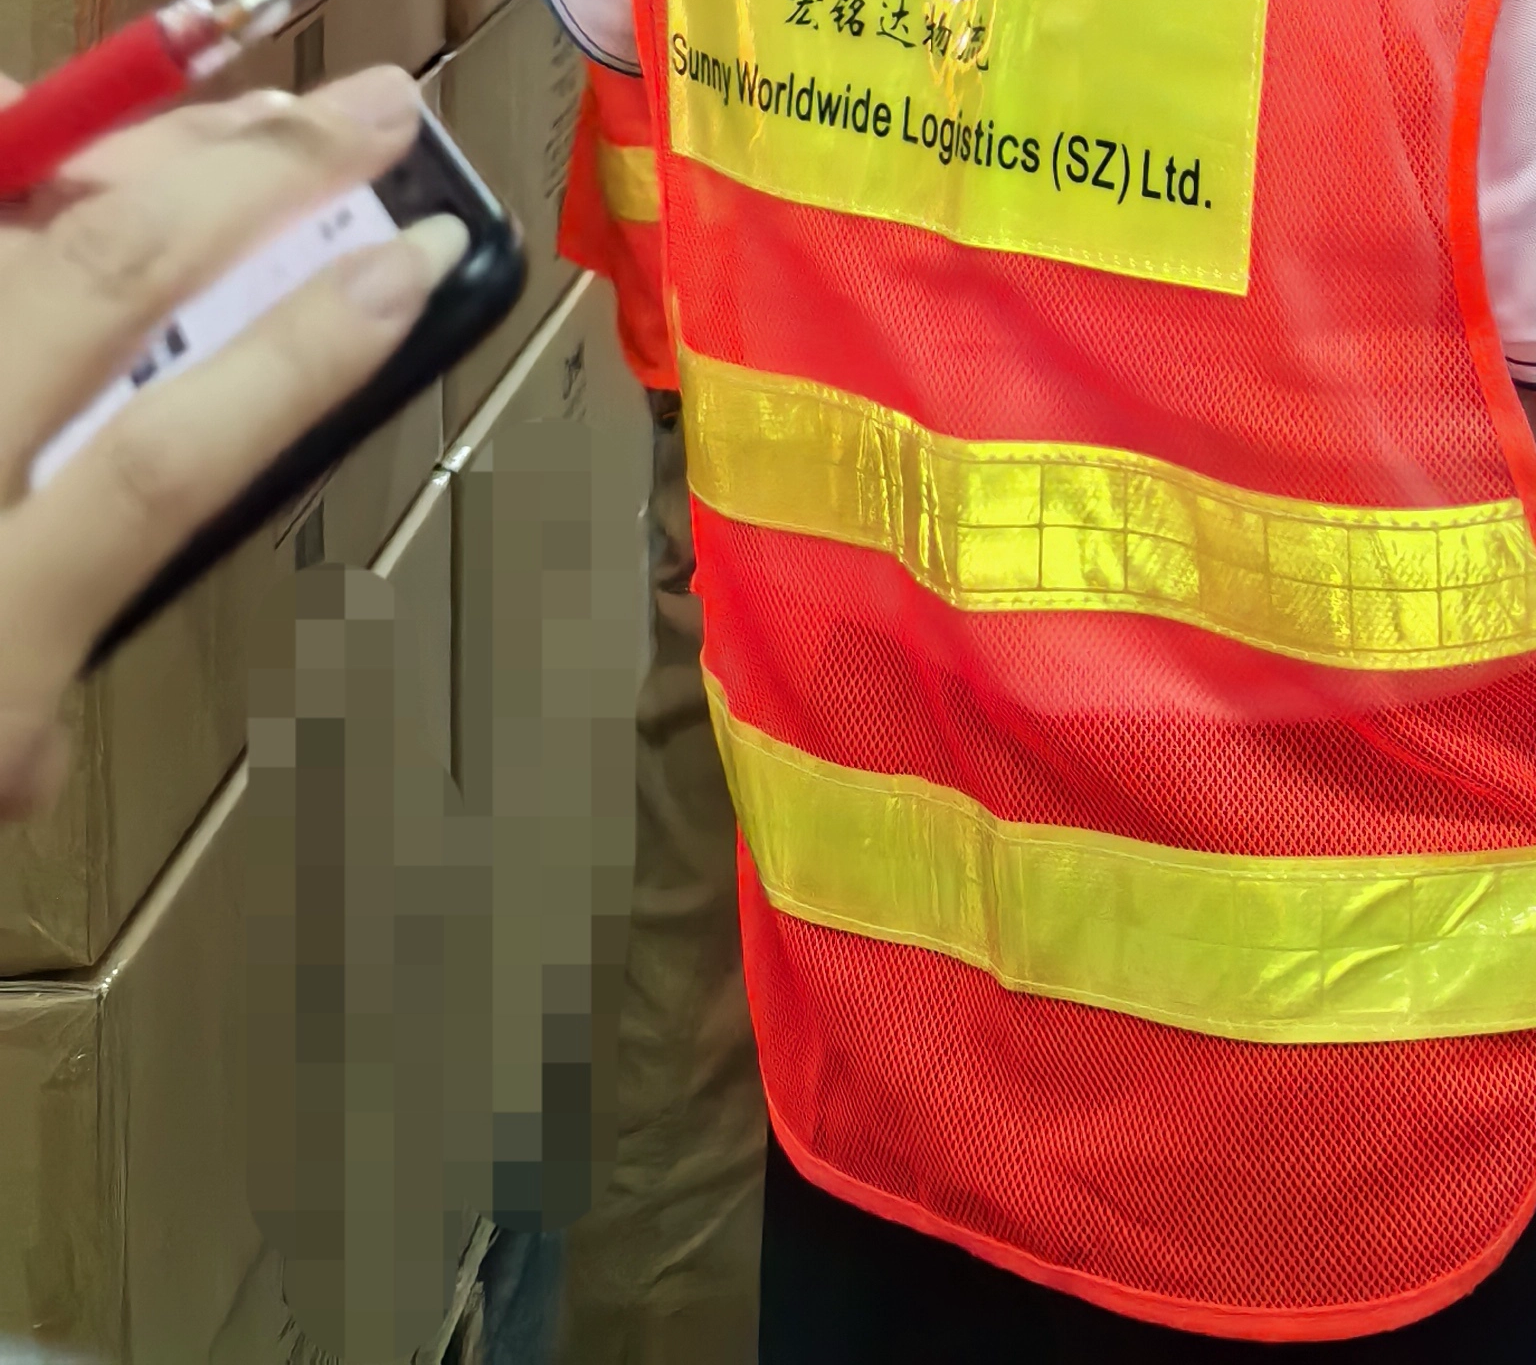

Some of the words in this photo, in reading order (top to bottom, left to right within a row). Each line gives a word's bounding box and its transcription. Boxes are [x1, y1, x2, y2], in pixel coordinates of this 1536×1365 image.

[671, 34, 732, 106] Sunny
[736, 59, 893, 139] Worldwide
[902, 95, 1040, 177] Logistics
[1051, 130, 1132, 206] (SZ)
[1140, 150, 1214, 209] Ltd.
